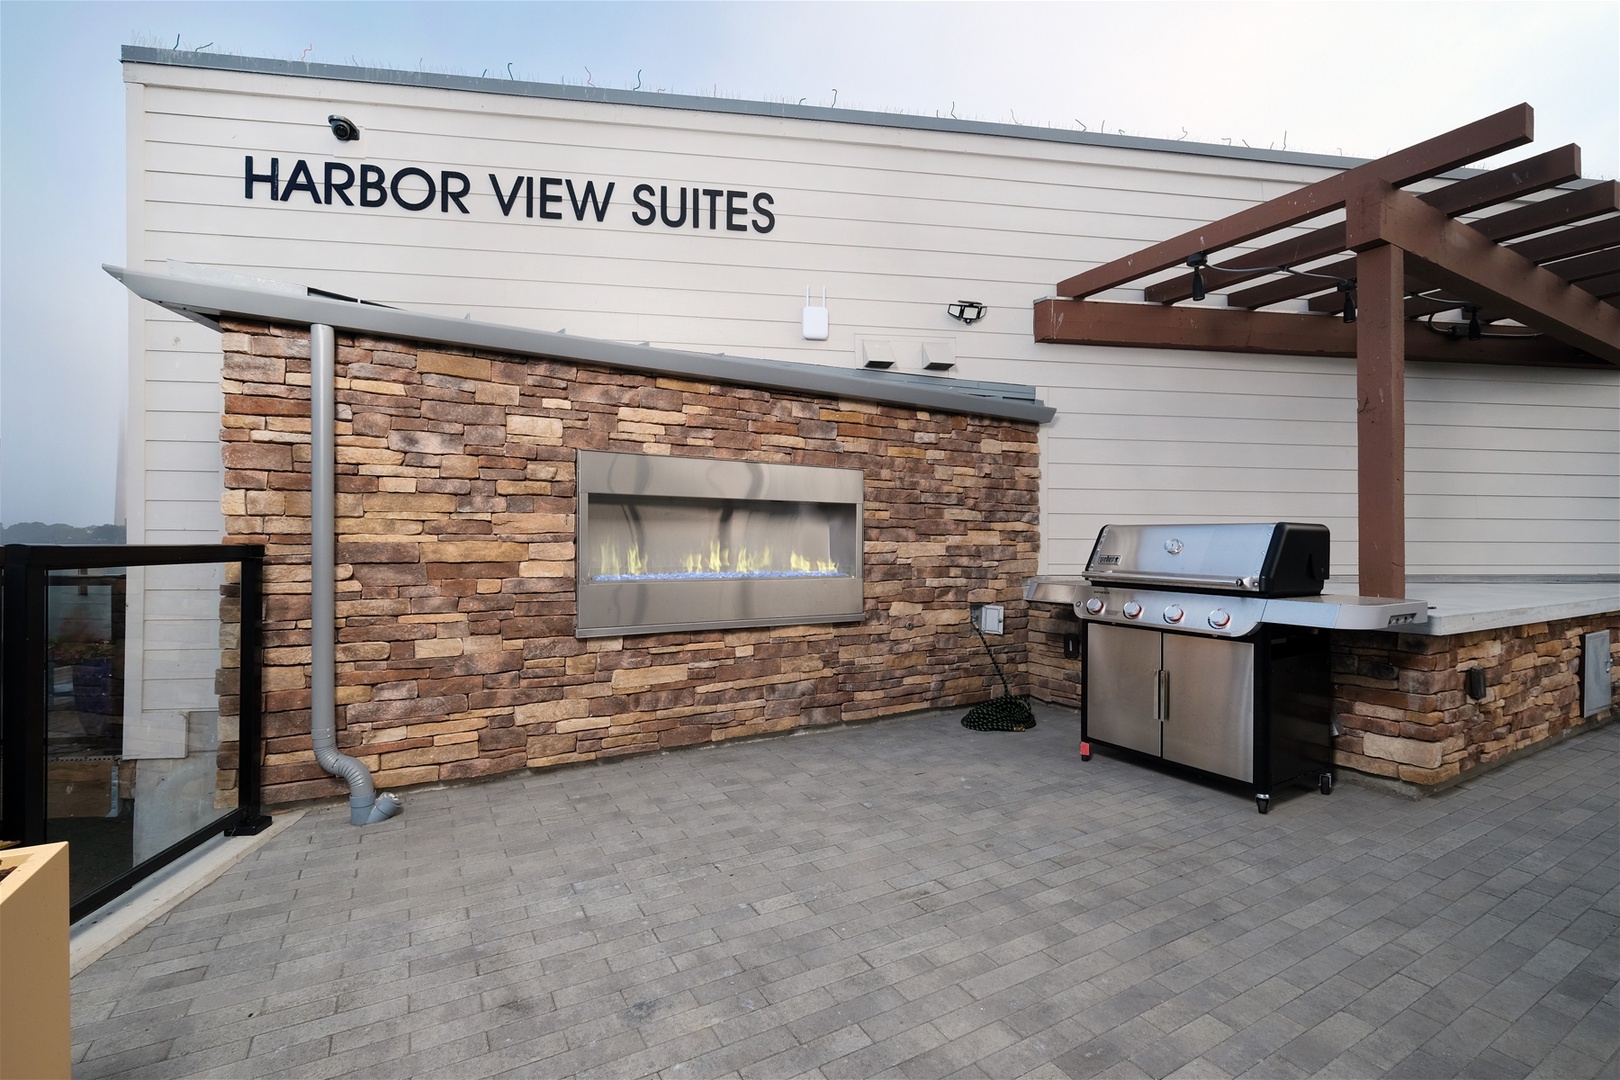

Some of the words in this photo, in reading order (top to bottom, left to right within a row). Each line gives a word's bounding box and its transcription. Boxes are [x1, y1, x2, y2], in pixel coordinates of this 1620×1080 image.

[245, 156, 470, 213] HARBOR
[489, 174, 615, 222] VIEW
[632, 184, 775, 233] SUITES
